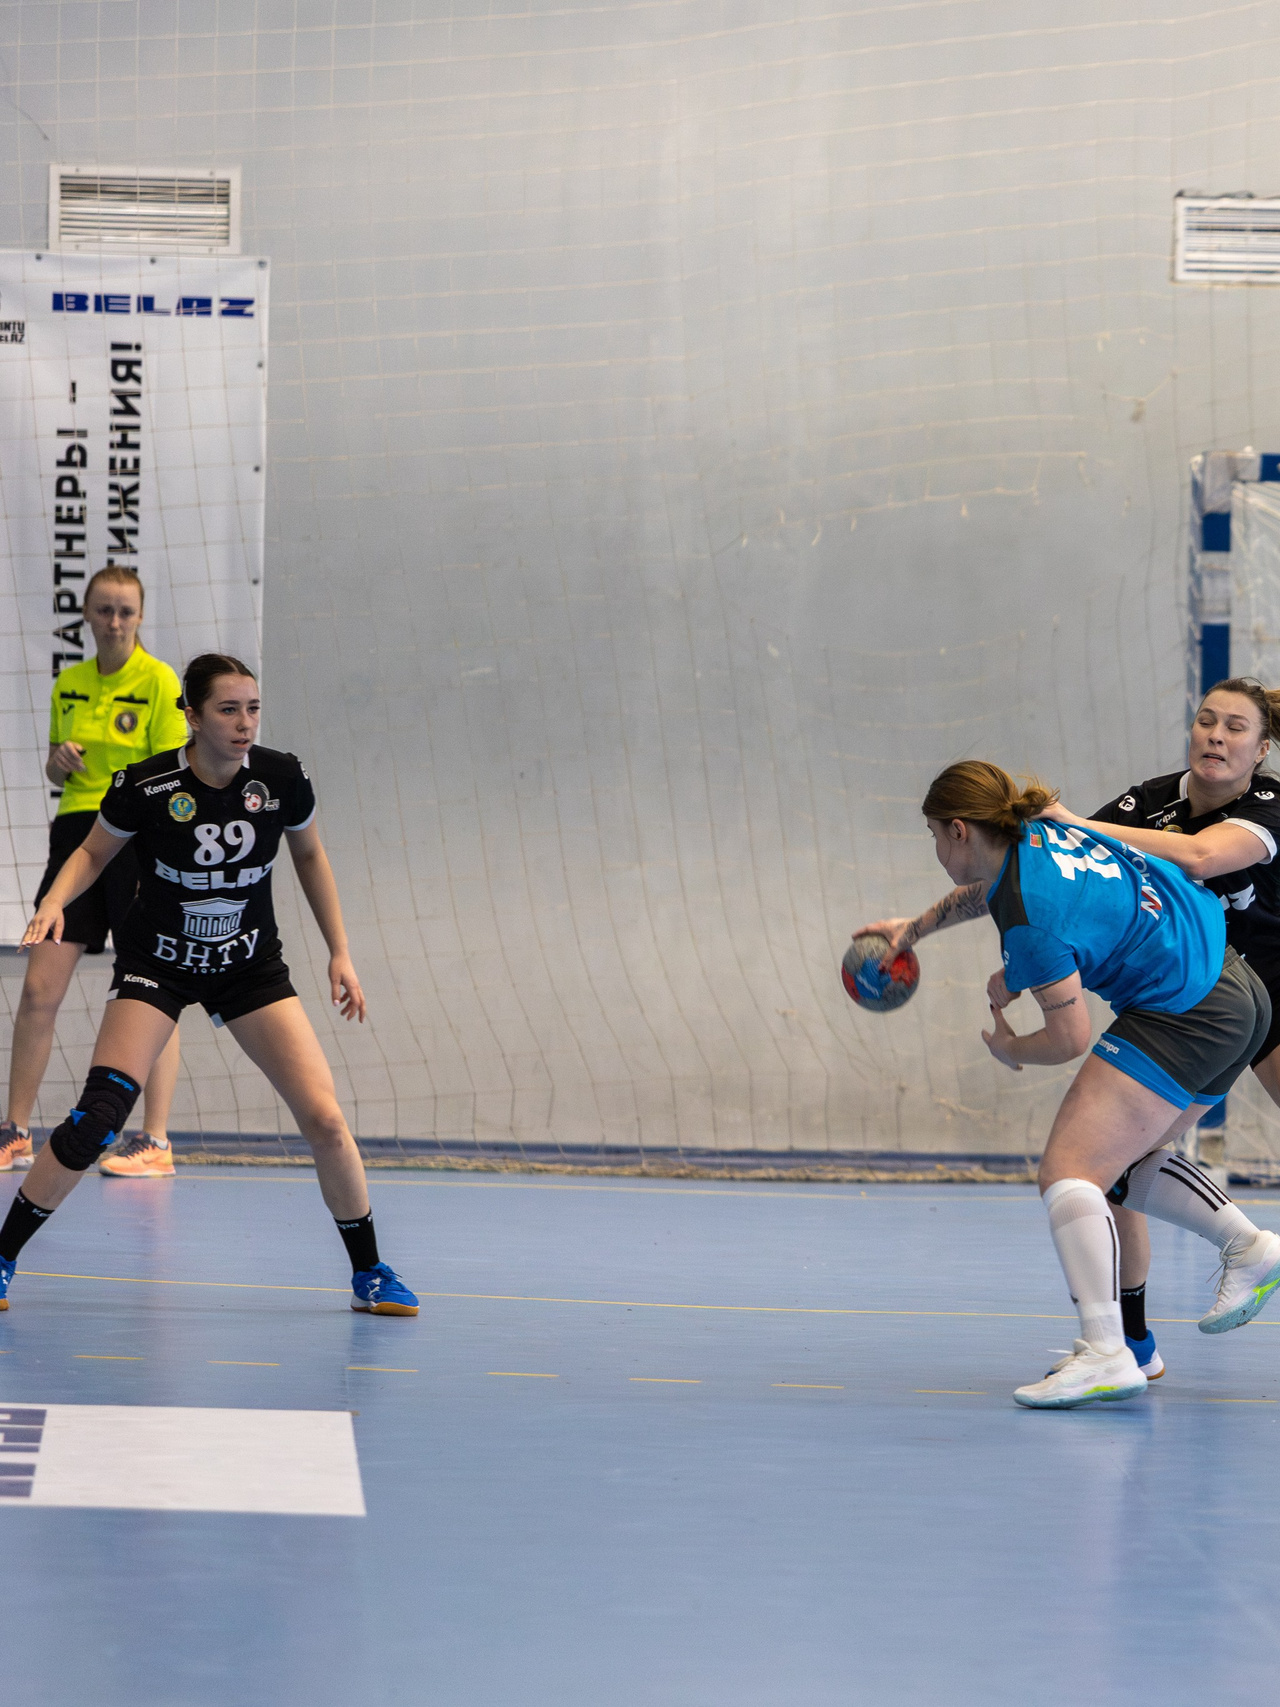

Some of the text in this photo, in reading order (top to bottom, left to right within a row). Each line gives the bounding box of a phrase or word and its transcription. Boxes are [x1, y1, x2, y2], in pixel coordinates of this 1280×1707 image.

[52, 291, 255, 318] BELAZ
[53, 428, 88, 678] ПАРТНЕРЫ
[144, 779, 181, 796] Kempa
[193, 820, 256, 867] 89
[153, 928, 260, 967] БНТУ
[123, 973, 159, 989] Kempa
